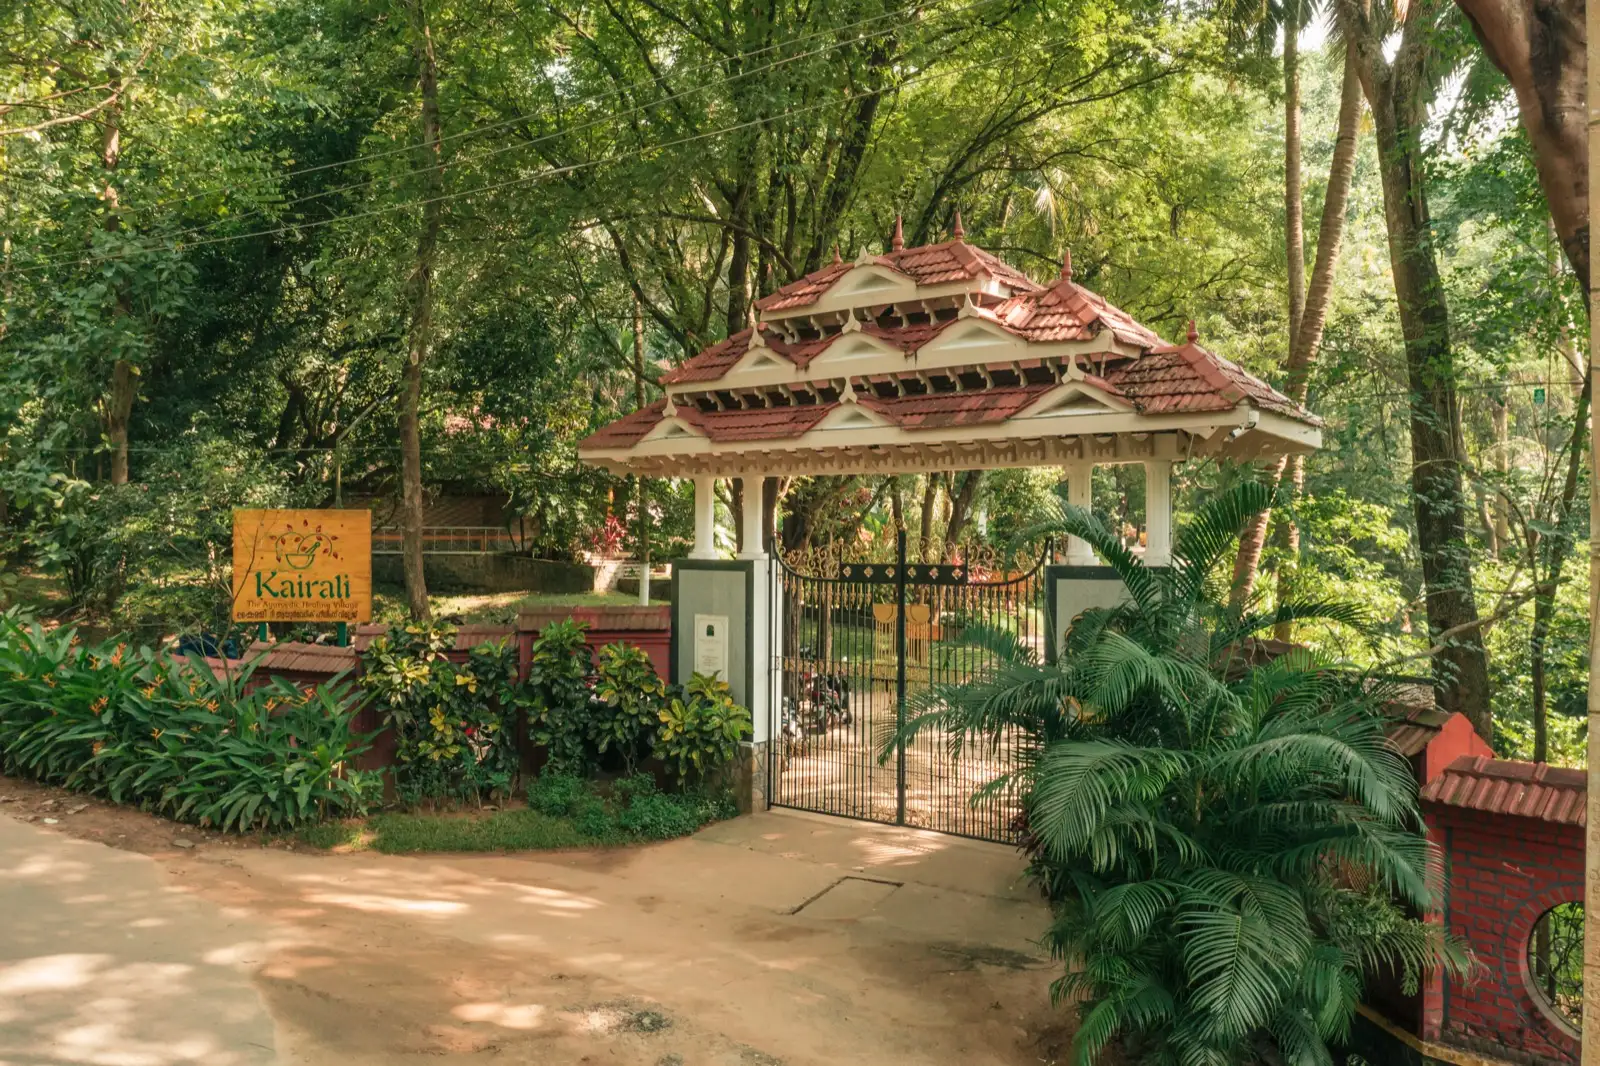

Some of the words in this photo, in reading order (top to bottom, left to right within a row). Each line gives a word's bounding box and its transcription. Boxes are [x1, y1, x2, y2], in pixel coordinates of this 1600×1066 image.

[255, 571, 351, 598] Kairali
[247, 600, 261, 608] The
[302, 600, 331, 609] Healing
[333, 599, 359, 610] Village
